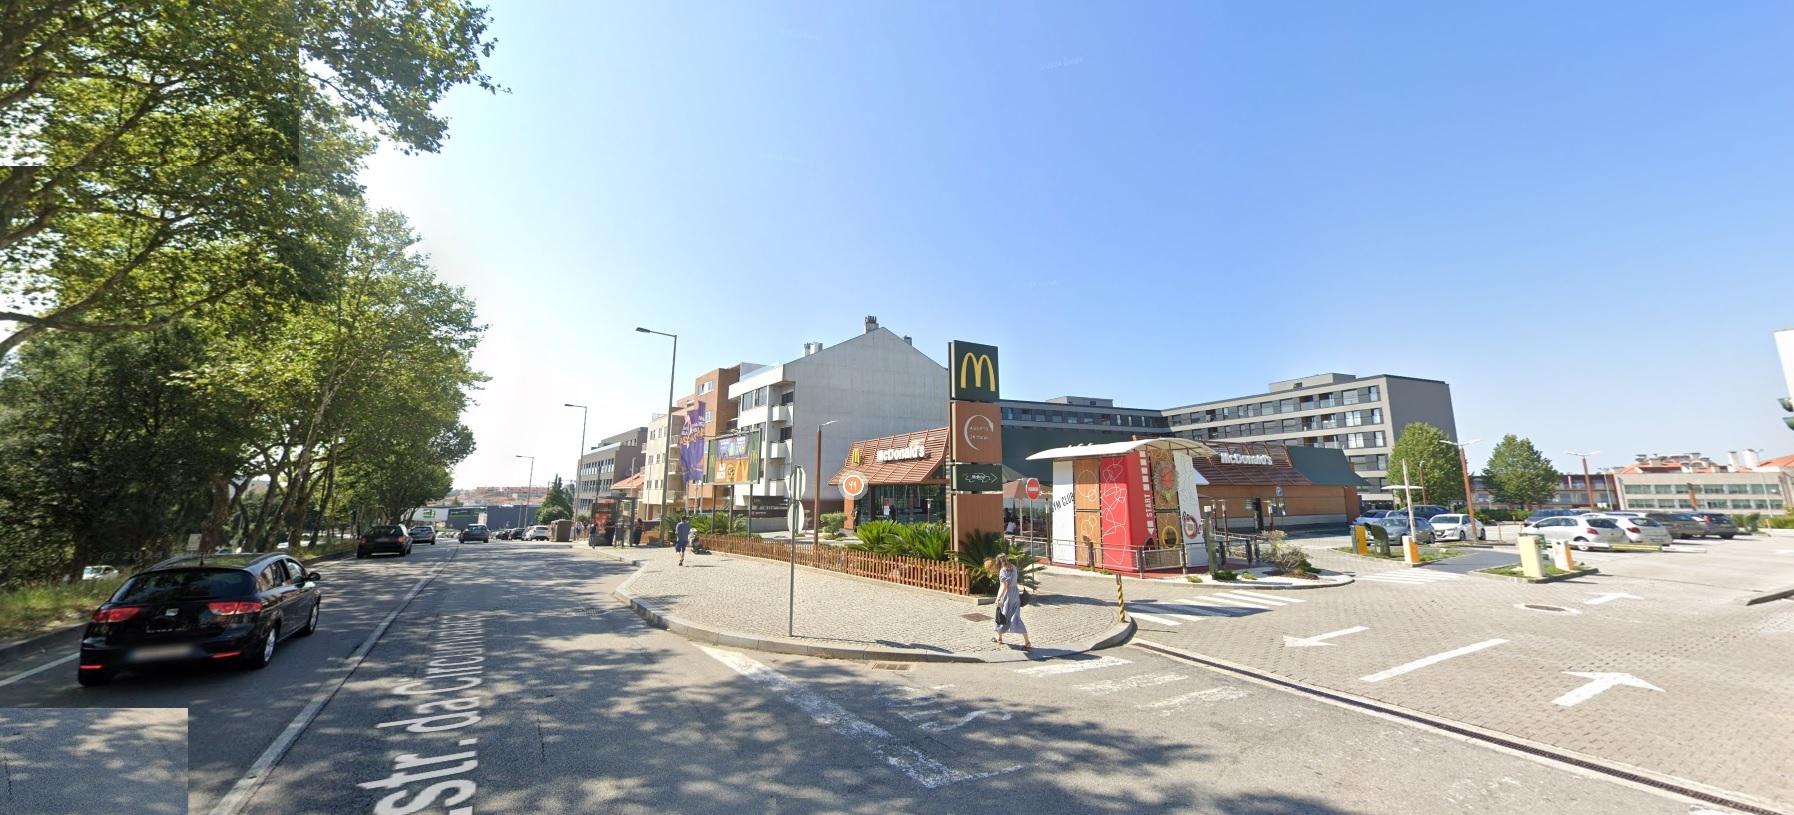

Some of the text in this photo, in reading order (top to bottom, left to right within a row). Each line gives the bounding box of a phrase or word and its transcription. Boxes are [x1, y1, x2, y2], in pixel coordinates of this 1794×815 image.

[876, 446, 925, 463] McDonald's
[1220, 452, 1273, 466] McDonald's
[1144, 494, 1153, 518] START
